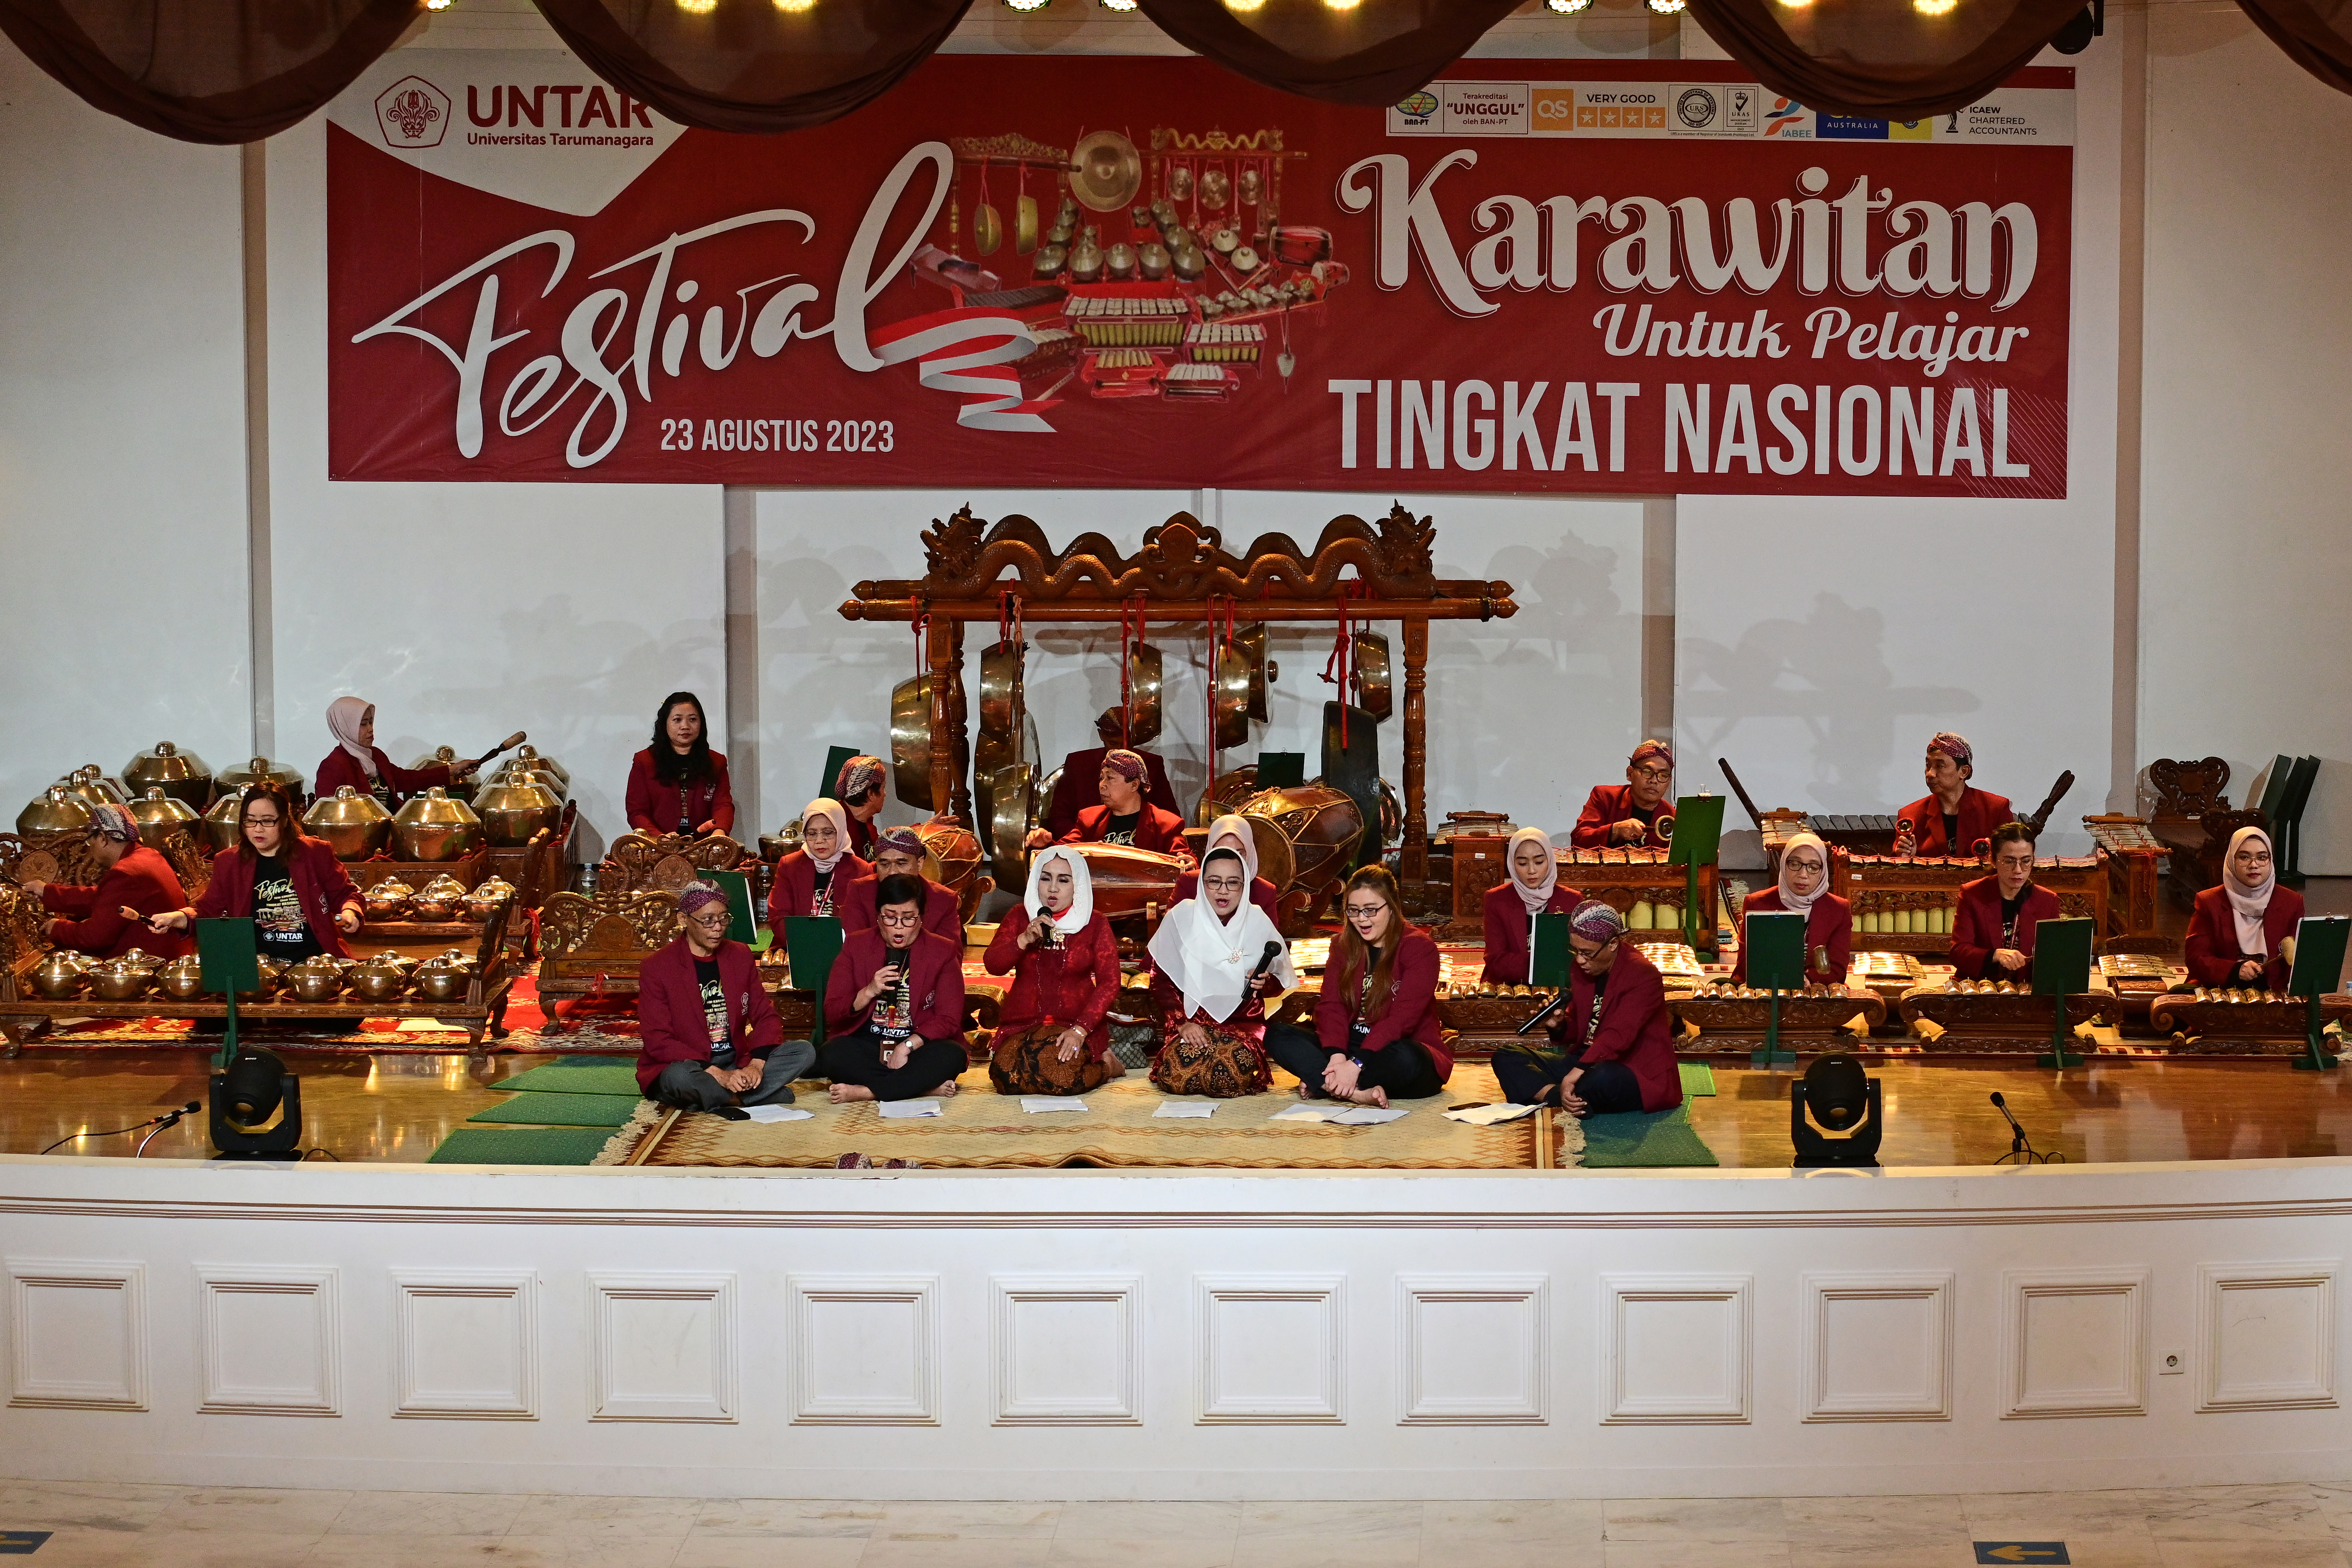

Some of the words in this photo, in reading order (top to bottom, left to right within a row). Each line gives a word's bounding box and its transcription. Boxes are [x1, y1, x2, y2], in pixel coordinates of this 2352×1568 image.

[467, 85, 653, 128] UNTAR
[1537, 100, 1568, 121] QS
[1586, 94, 1617, 103] VERY
[1620, 94, 1656, 103] GOOD
[1689, 105, 1705, 115] URS
[467, 133, 546, 146] Universitas
[550, 133, 654, 149] Tarumanagara
[1782, 130, 1812, 138] IABEE
[1969, 127, 2037, 135] ACCOUNTANTS
[1335, 148, 2039, 319] Karawitan
[351, 141, 954, 469] Festival
[1593, 303, 1791, 359] Untuk
[1805, 306, 2030, 378] Pelajar
[660, 418, 694, 452] 23
[702, 419, 819, 453] AGUSTUS
[827, 419, 895, 453] 2023
[1328, 379, 1640, 473] TINGKAT
[1665, 382, 2030, 478] NASIONAL
